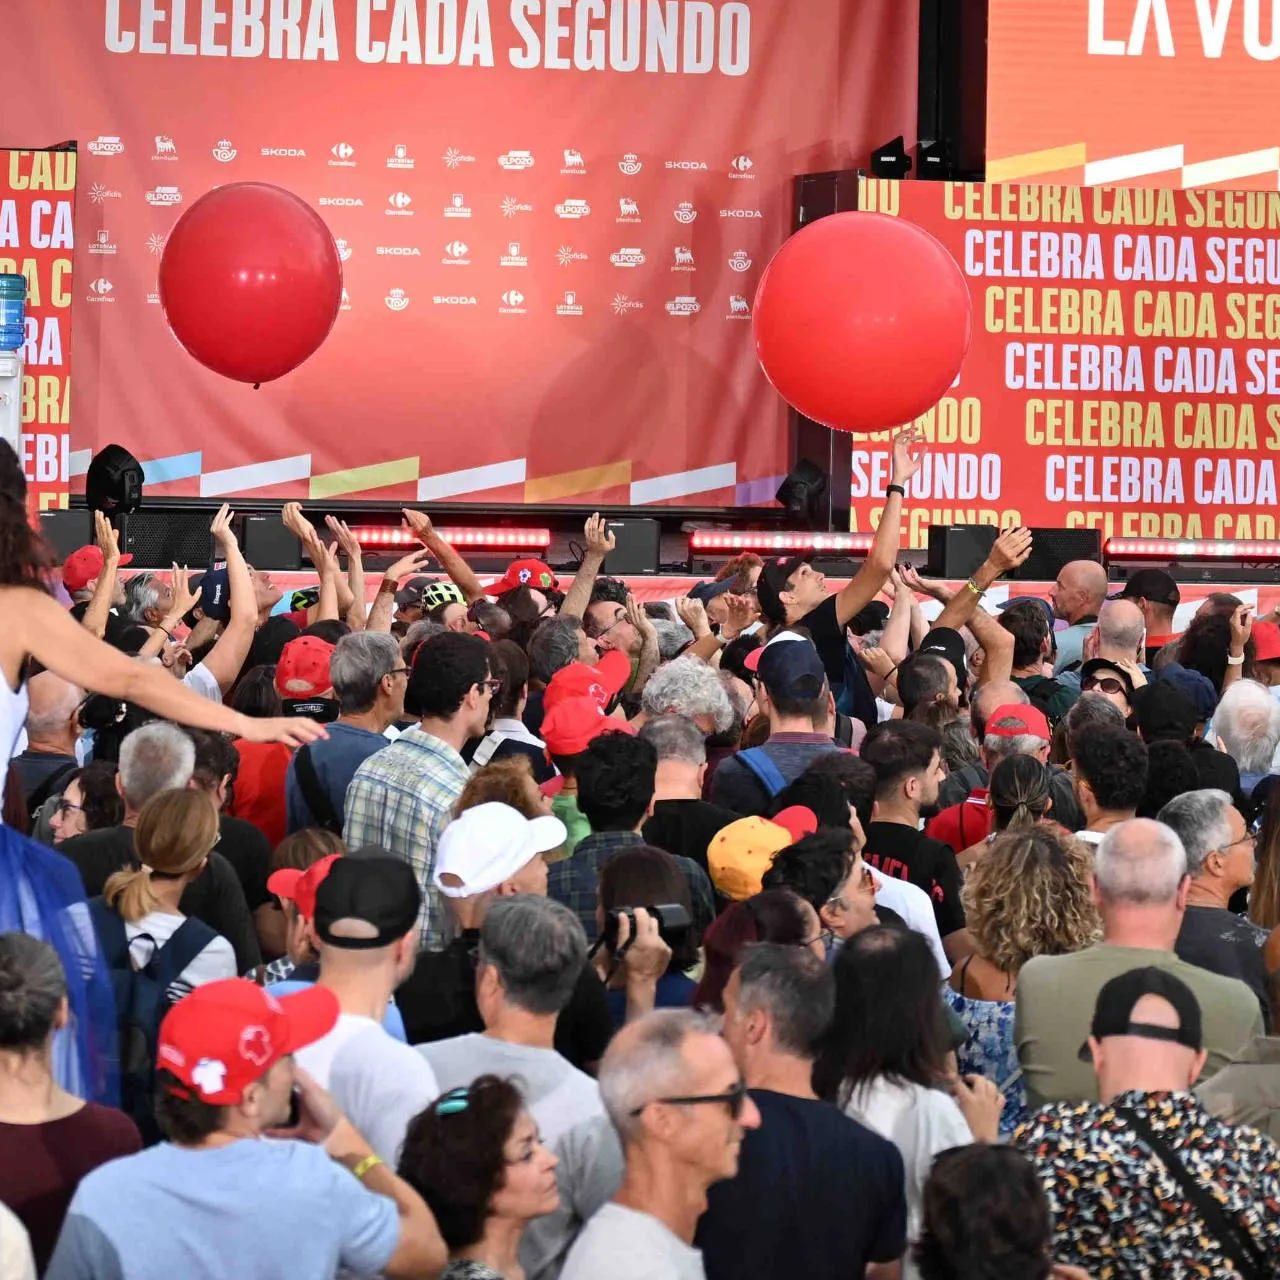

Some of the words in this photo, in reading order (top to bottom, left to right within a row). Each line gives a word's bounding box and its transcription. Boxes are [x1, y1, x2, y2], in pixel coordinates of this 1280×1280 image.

[943, 181, 1084, 224] CELEBRA
[1093, 186, 1178, 228] CADA
[964, 228, 1105, 281] CELEBRA
[1113, 233, 1198, 283] CADA
[984, 285, 1125, 337] CELEBRA
[1133, 289, 1218, 339] CADA
[1004, 341, 1145, 392] CELEBRA
[1153, 345, 1238, 395] CADA
[1025, 397, 1165, 449] CELEBRA
[1174, 401, 1258, 450] CADA
[850, 449, 1002, 501] SEUNDO
[1044, 453, 1185, 504] CELEBRA
[1193, 457, 1278, 506] CADA
